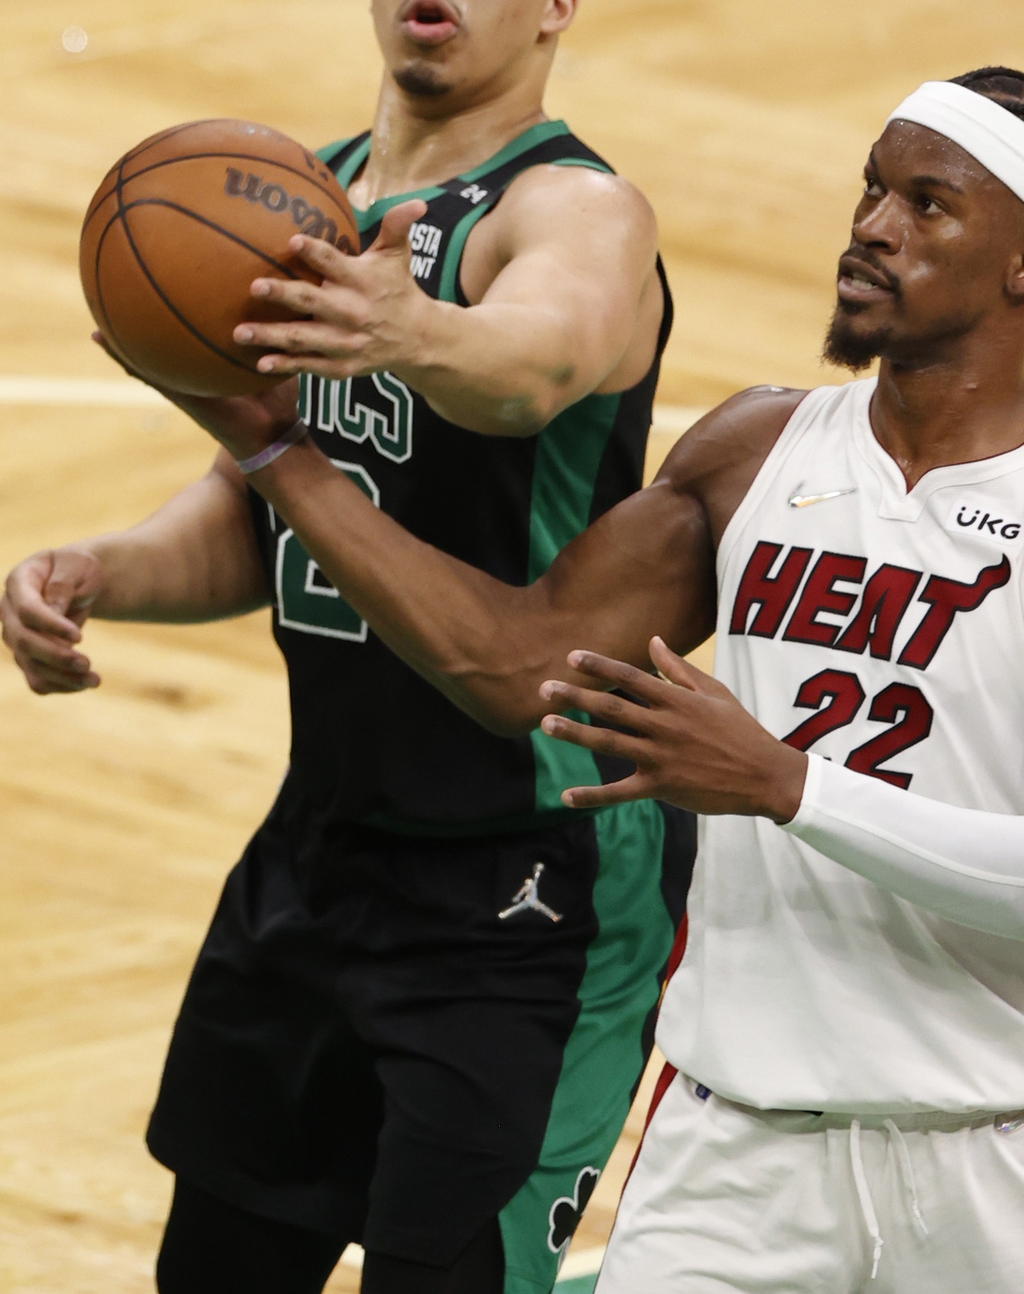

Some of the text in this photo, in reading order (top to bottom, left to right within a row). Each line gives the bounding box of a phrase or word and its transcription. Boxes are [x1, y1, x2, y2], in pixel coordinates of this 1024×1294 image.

[460, 184, 488, 204] 24
[409, 223, 442, 257] ISTA
[729, 540, 1011, 671] HEAT
[781, 668, 934, 790] 22
